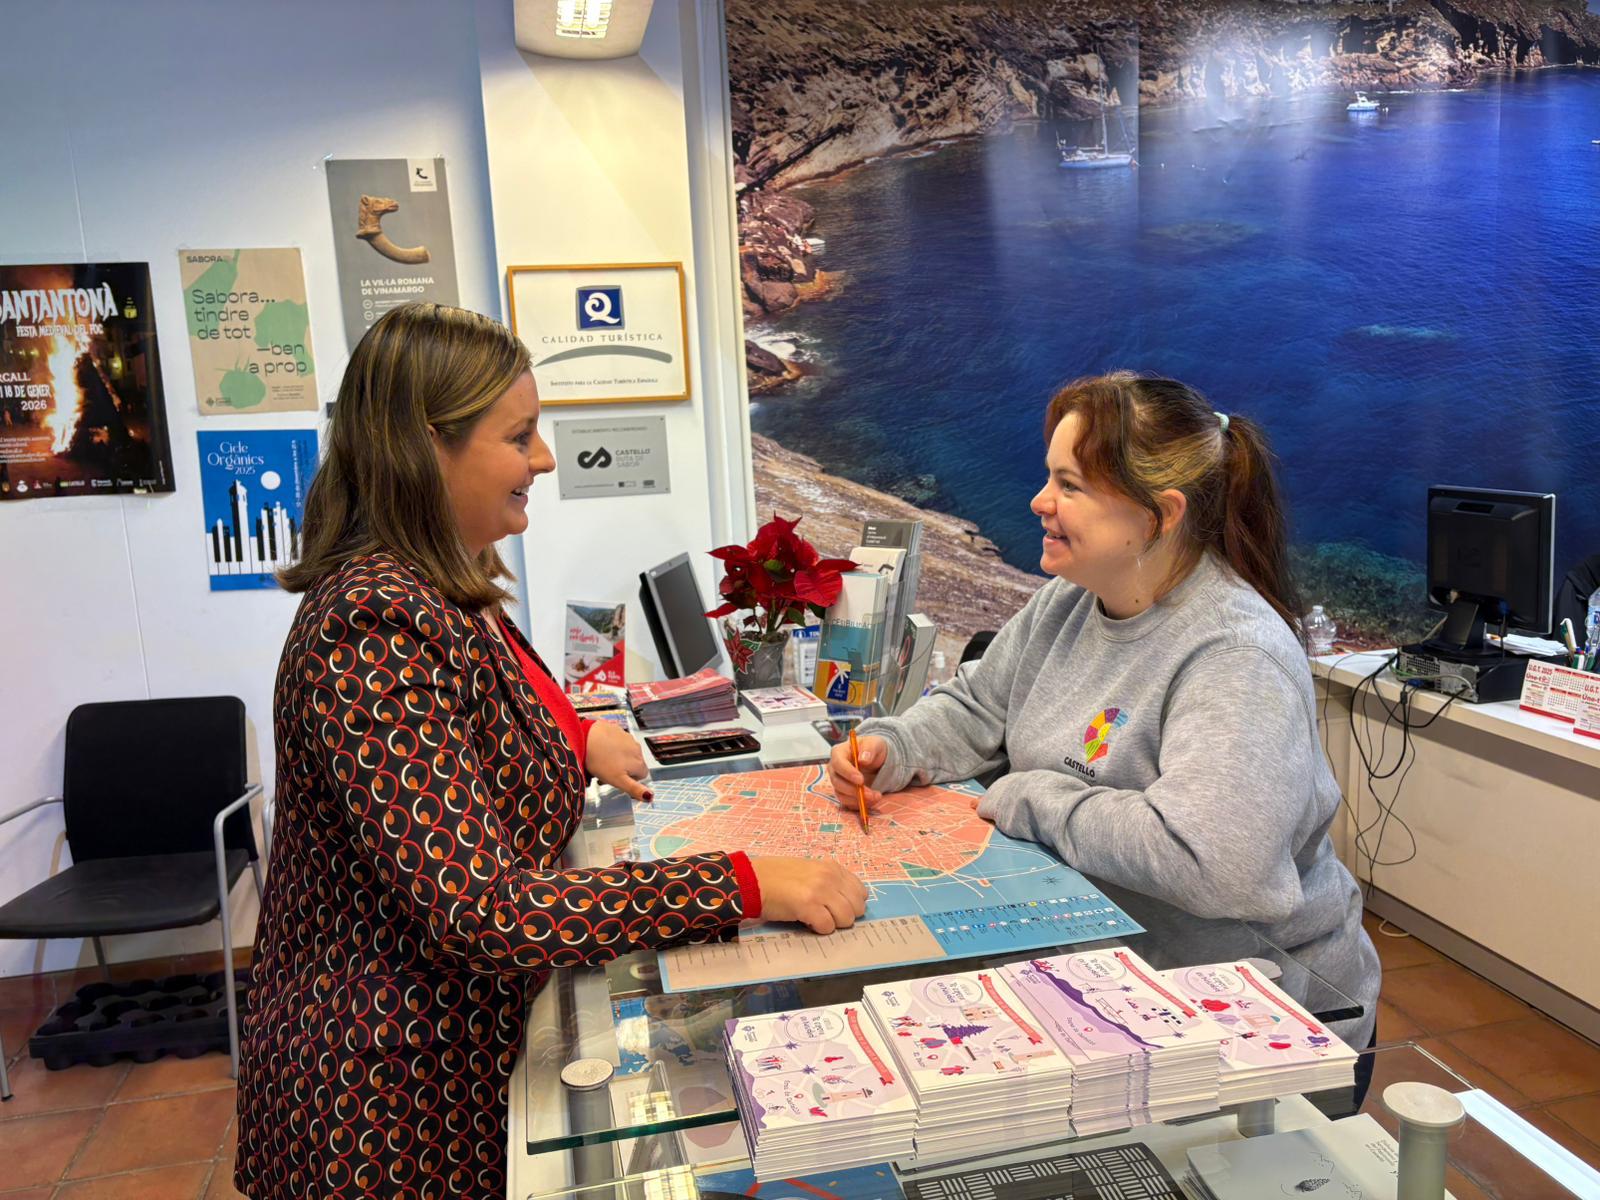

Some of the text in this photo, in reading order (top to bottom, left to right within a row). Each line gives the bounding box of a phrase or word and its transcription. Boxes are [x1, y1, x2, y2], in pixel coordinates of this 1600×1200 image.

[186, 255, 224, 263] SABORA
[360, 279, 371, 287] LA
[397, 276, 434, 286] ROMANA
[191, 288, 276, 304] Sabora...
[361, 285, 425, 296] DE VINAMARGO
[194, 306, 249, 322] tindre
[584, 292, 620, 325] Q
[16, 323, 104, 338] FESTA MEDIEVAL DEL FOC
[196, 325, 252, 340] de tot
[542, 332, 664, 344] CALIDAD TURÍSTICA
[249, 360, 308, 377] a prop
[14, 385, 26, 399] DE
[27, 384, 52, 400] GENER
[21, 399, 48, 411] 2026
[219, 440, 249, 454] Cicle
[234, 466, 256, 475] 2025
[1063, 756, 1096, 778] CASTELLÓ
